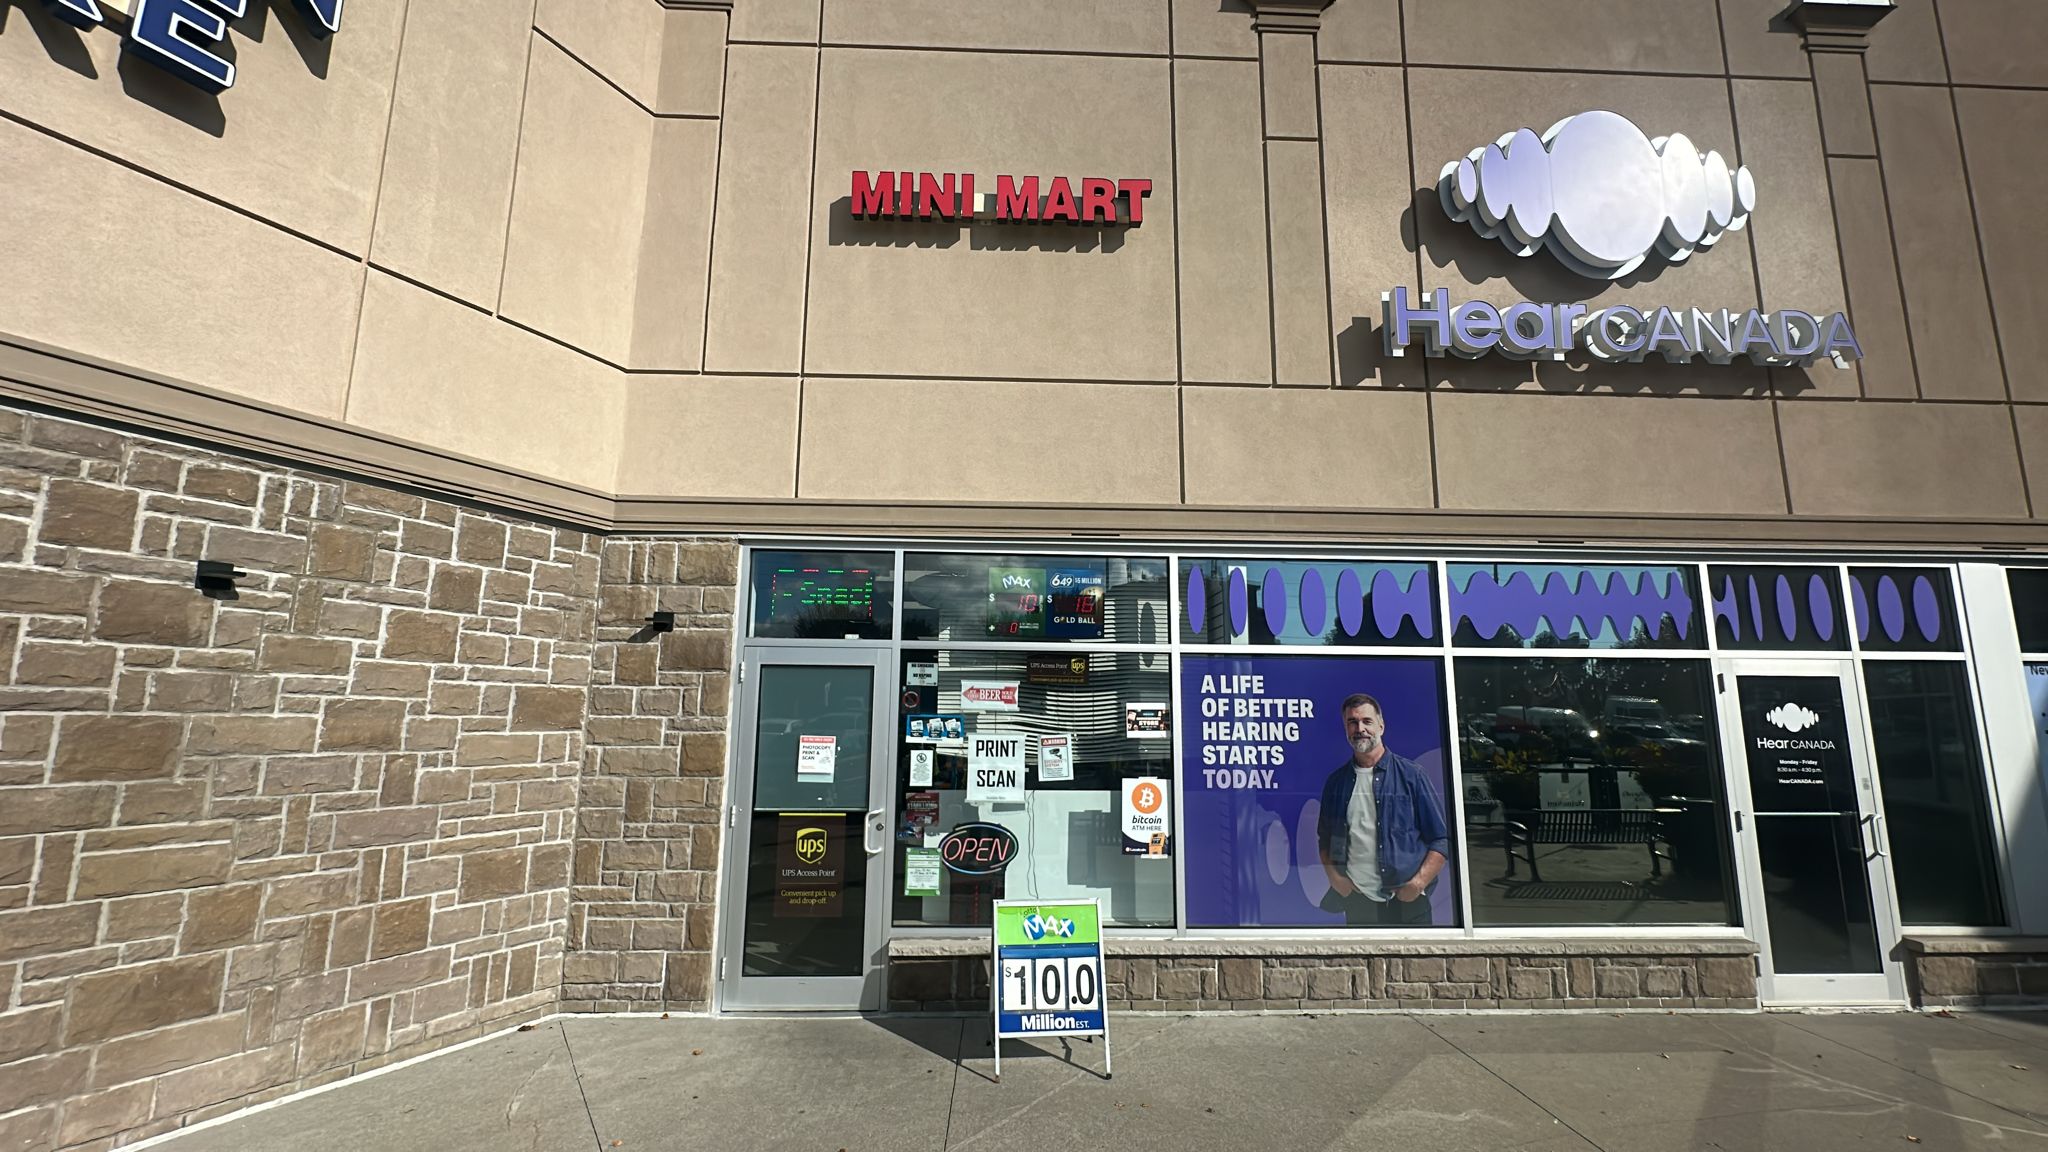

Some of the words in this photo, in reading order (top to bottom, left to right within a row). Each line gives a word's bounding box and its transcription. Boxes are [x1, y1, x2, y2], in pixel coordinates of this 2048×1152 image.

[851, 170, 974, 218] MINI
[996, 175, 1152, 226] MART
[1392, 286, 1586, 349] Hear
[1599, 304, 1864, 360] CANADA
[1051, 574, 1073, 587] 649
[1078, 616, 1096, 625] BALL
[1072, 662, 1085, 671] ups
[1201, 675, 1216, 694] A
[1220, 675, 1264, 694] LIFE
[980, 689, 1001, 701] BEER
[1202, 698, 1229, 717] OF
[1234, 698, 1314, 718] BETTER
[1203, 722, 1299, 741] HEARING
[976, 740, 1018, 757] PRINT
[1757, 737, 1789, 749] Hear
[1790, 740, 1835, 750] CANADA
[1203, 745, 1284, 765] STARTS
[976, 770, 1016, 788] SCAN
[1203, 769, 1278, 789] TODAY.
[1132, 815, 1162, 824] bitcoin
[798, 839, 824, 858] ups
[943, 838, 1010, 861] OPEN
[814, 890, 828, 898] pick
[1023, 906, 1073, 940] MAX
[1021, 1013, 1076, 1031] Million
[1075, 1020, 1090, 1029] EST.
